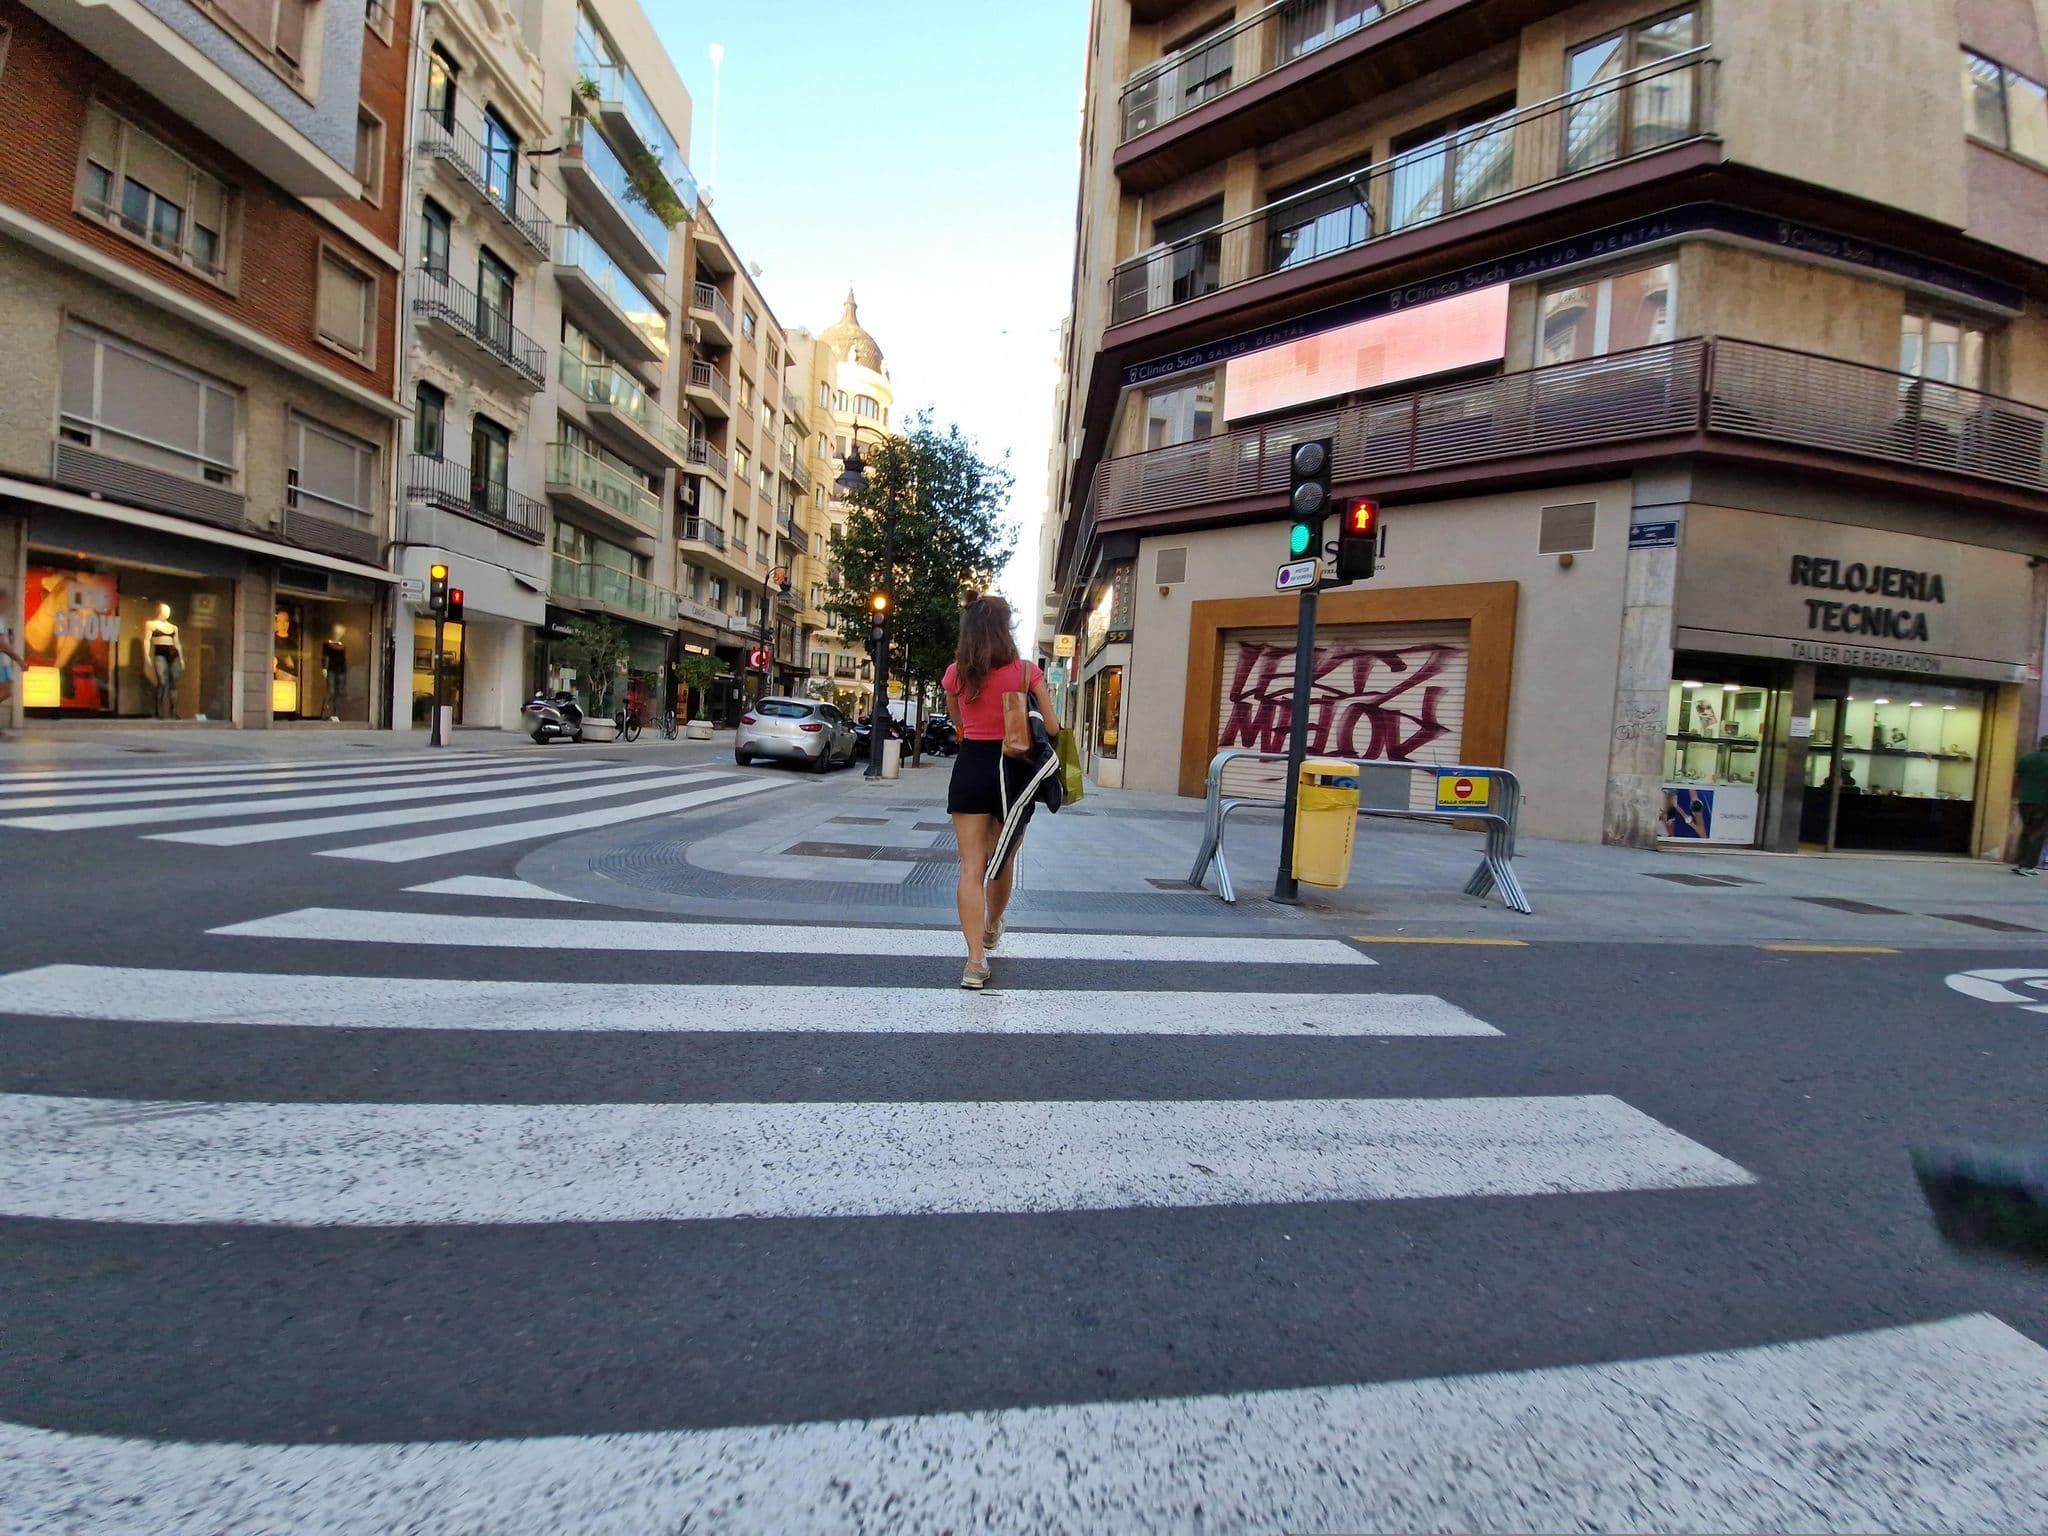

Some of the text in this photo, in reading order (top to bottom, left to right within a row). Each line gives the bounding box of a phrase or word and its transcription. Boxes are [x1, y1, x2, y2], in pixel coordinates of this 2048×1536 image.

[1465, 266, 1506, 287] Such
[1514, 247, 1577, 273] SALUD
[1592, 223, 1673, 252] DENTAL
[1177, 353, 1202, 369] Such
[1256, 328, 1306, 345] DENTAL
[1790, 554, 1946, 604] RELOJERIA
[55, 609, 121, 641] SHOW
[1109, 631, 1127, 641] 59
[1804, 598, 1930, 642] TECNICA
[1791, 642, 1942, 673] TALLER DE REPARACION
